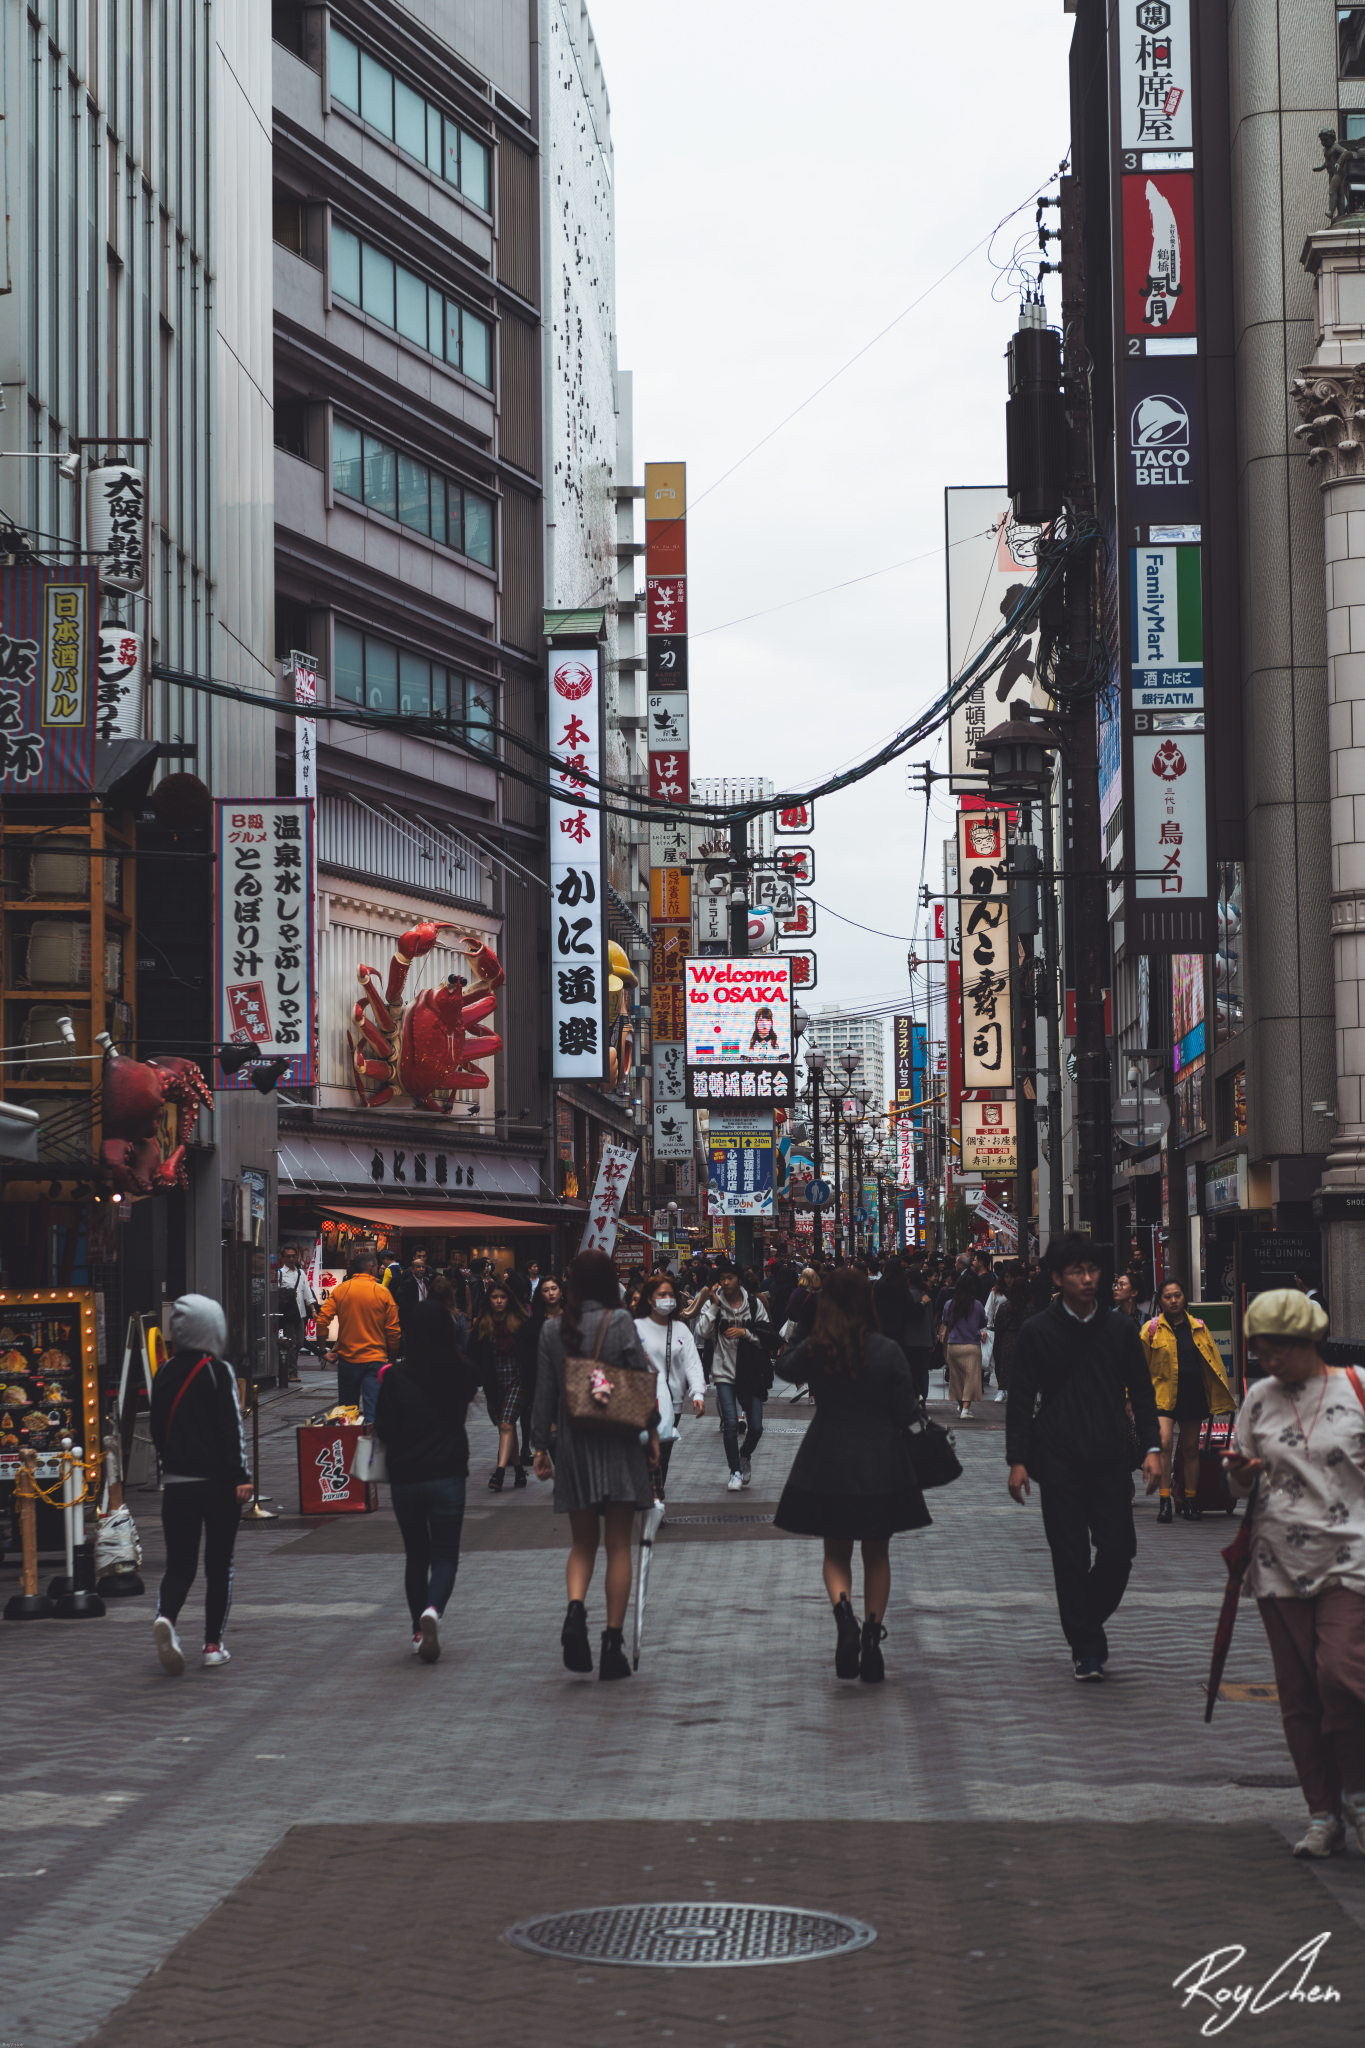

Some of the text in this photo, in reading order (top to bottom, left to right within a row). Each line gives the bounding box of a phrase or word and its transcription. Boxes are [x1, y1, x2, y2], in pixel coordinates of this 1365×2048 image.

[1135, 35, 1175, 142] 相席屋
[1124, 153, 1137, 170] 3
[1157, 249, 1170, 272] 鶴橋
[1139, 273, 1183, 325] 風月
[1129, 339, 1140, 355] 2
[1131, 450, 1190, 467] TACO
[1136, 468, 1189, 485] BELL
[1134, 526, 1140, 541] 1
[648, 580, 659, 588] 8F
[1142, 555, 1164, 660] FamilyMart
[52, 592, 79, 718] 日本酒バル
[1143, 672, 1192, 687] 酒 たばこ
[650, 698, 662, 708] 6F
[1142, 692, 1194, 705] 銀行ATM
[1135, 715, 1148, 730] B
[1164, 787, 1176, 815] 三代目
[231, 814, 264, 829] B級
[227, 831, 268, 843] グルメ
[1158, 820, 1183, 893] 鳥メロ
[761, 883, 792, 908] 牛角
[233, 846, 264, 977] とんぼり汁
[273, 814, 302, 1044] 温泉水しゃぶしゃぶ
[688, 963, 788, 983] Welcome
[689, 986, 789, 1003] to OSAKA
[898, 1018, 909, 1087] カラオケパセラ
[692, 1070, 789, 1098] 道頓堀商店会
[656, 1105, 668, 1114] 6F
[972, 1155, 1017, 1166] 寿司・和食
[728, 1198, 753, 1208] EDION
[1261, 1238, 1303, 1246] SHOCHIKU
[1253, 1248, 1311, 1257] THE DINING
